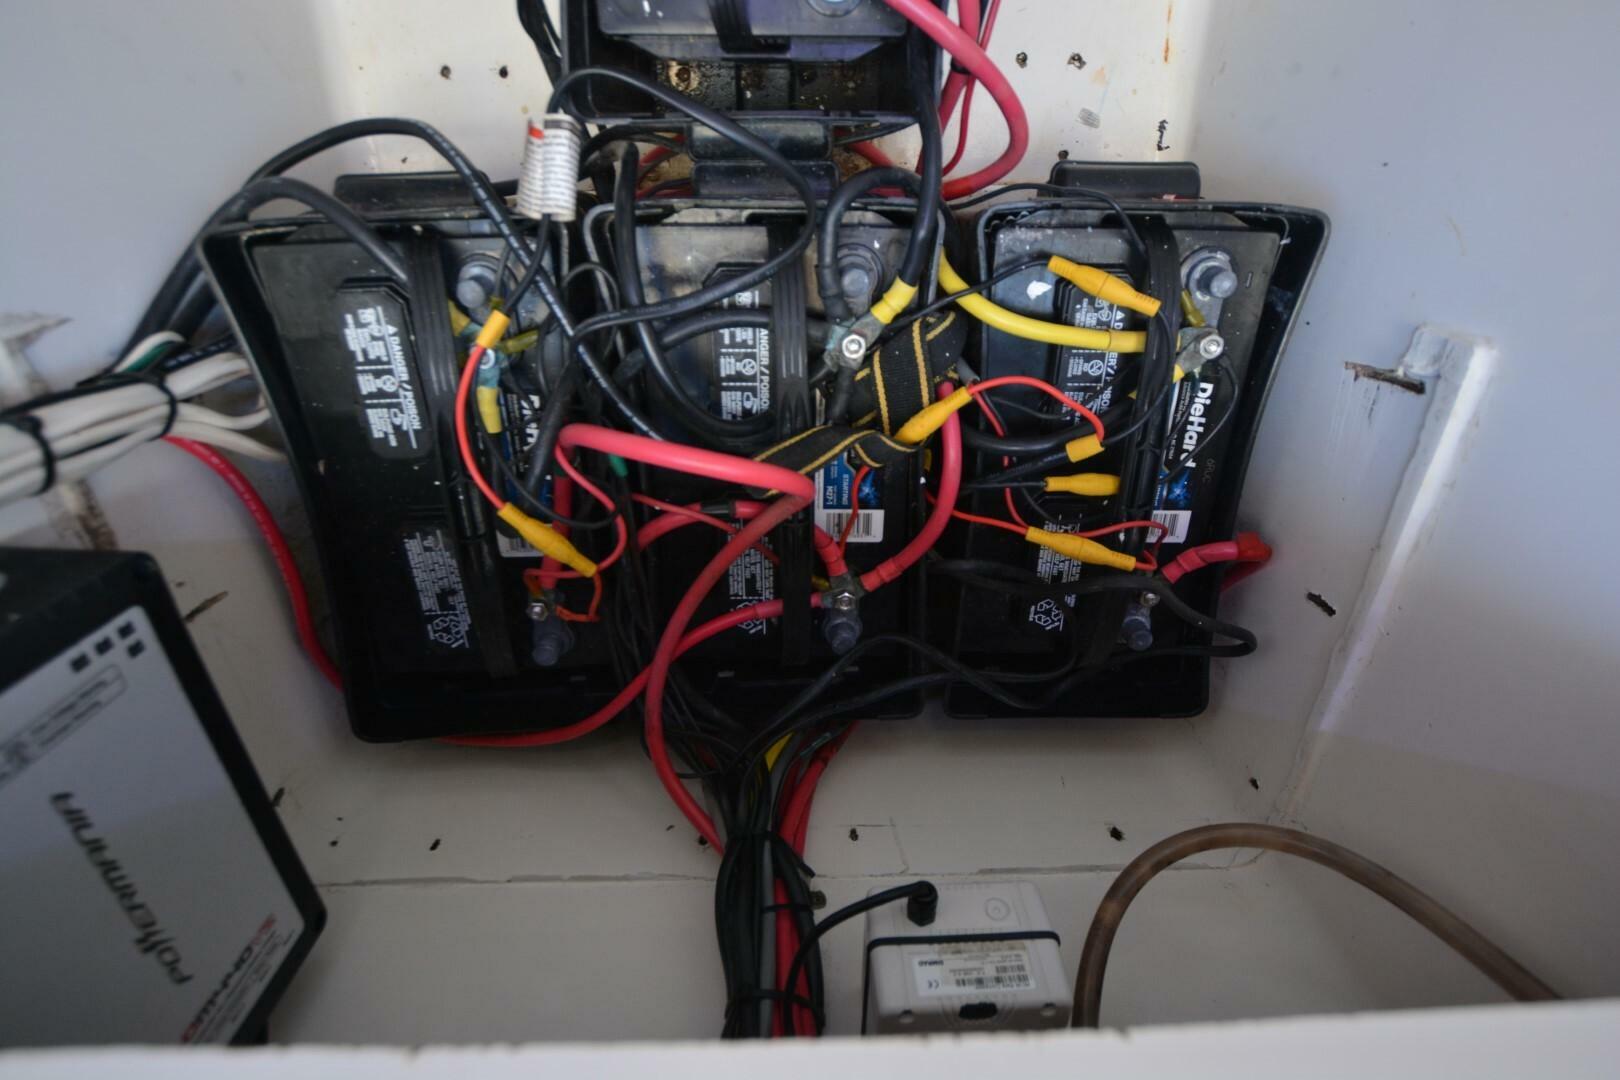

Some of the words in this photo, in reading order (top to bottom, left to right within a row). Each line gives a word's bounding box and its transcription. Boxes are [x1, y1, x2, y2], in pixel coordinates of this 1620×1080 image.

[759, 328, 769, 365] ANGER
[390, 336, 410, 381] DANGER
[403, 390, 422, 429] POISON
[759, 375, 769, 412] POISO
[1182, 381, 1213, 467] DieHard
